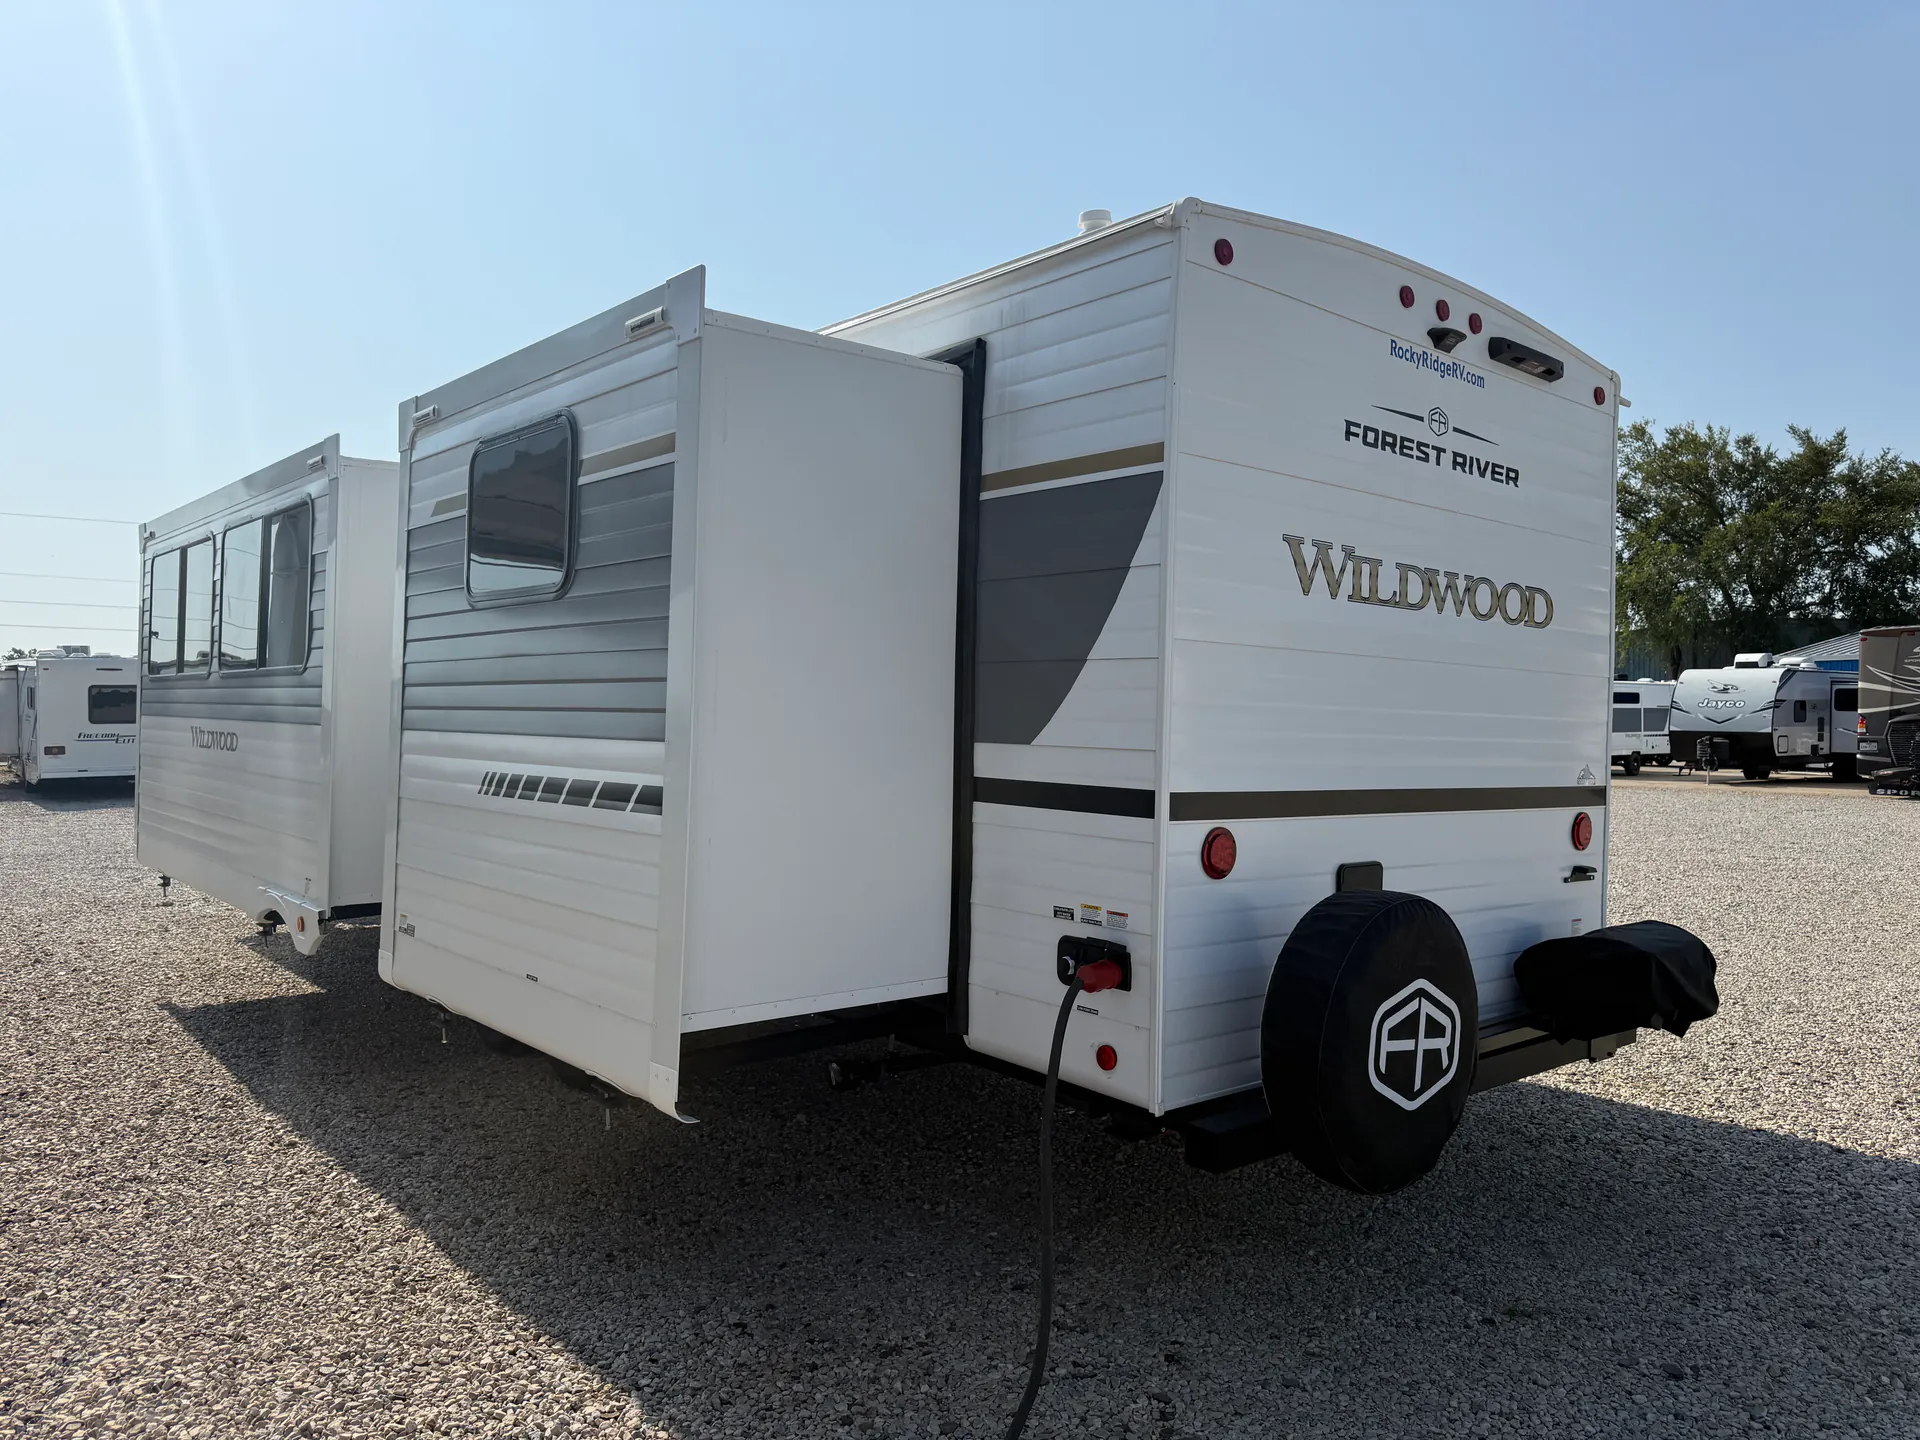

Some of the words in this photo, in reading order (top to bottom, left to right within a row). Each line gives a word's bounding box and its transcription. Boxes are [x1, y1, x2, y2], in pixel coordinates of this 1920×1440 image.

[1389, 338, 1486, 389] RockyRidgeRV.com
[1344, 418, 1447, 467] FOREST
[1451, 450, 1520, 488] RIVER
[1282, 533, 1554, 629] WILDWOOD
[1698, 698, 1746, 709] Jayco
